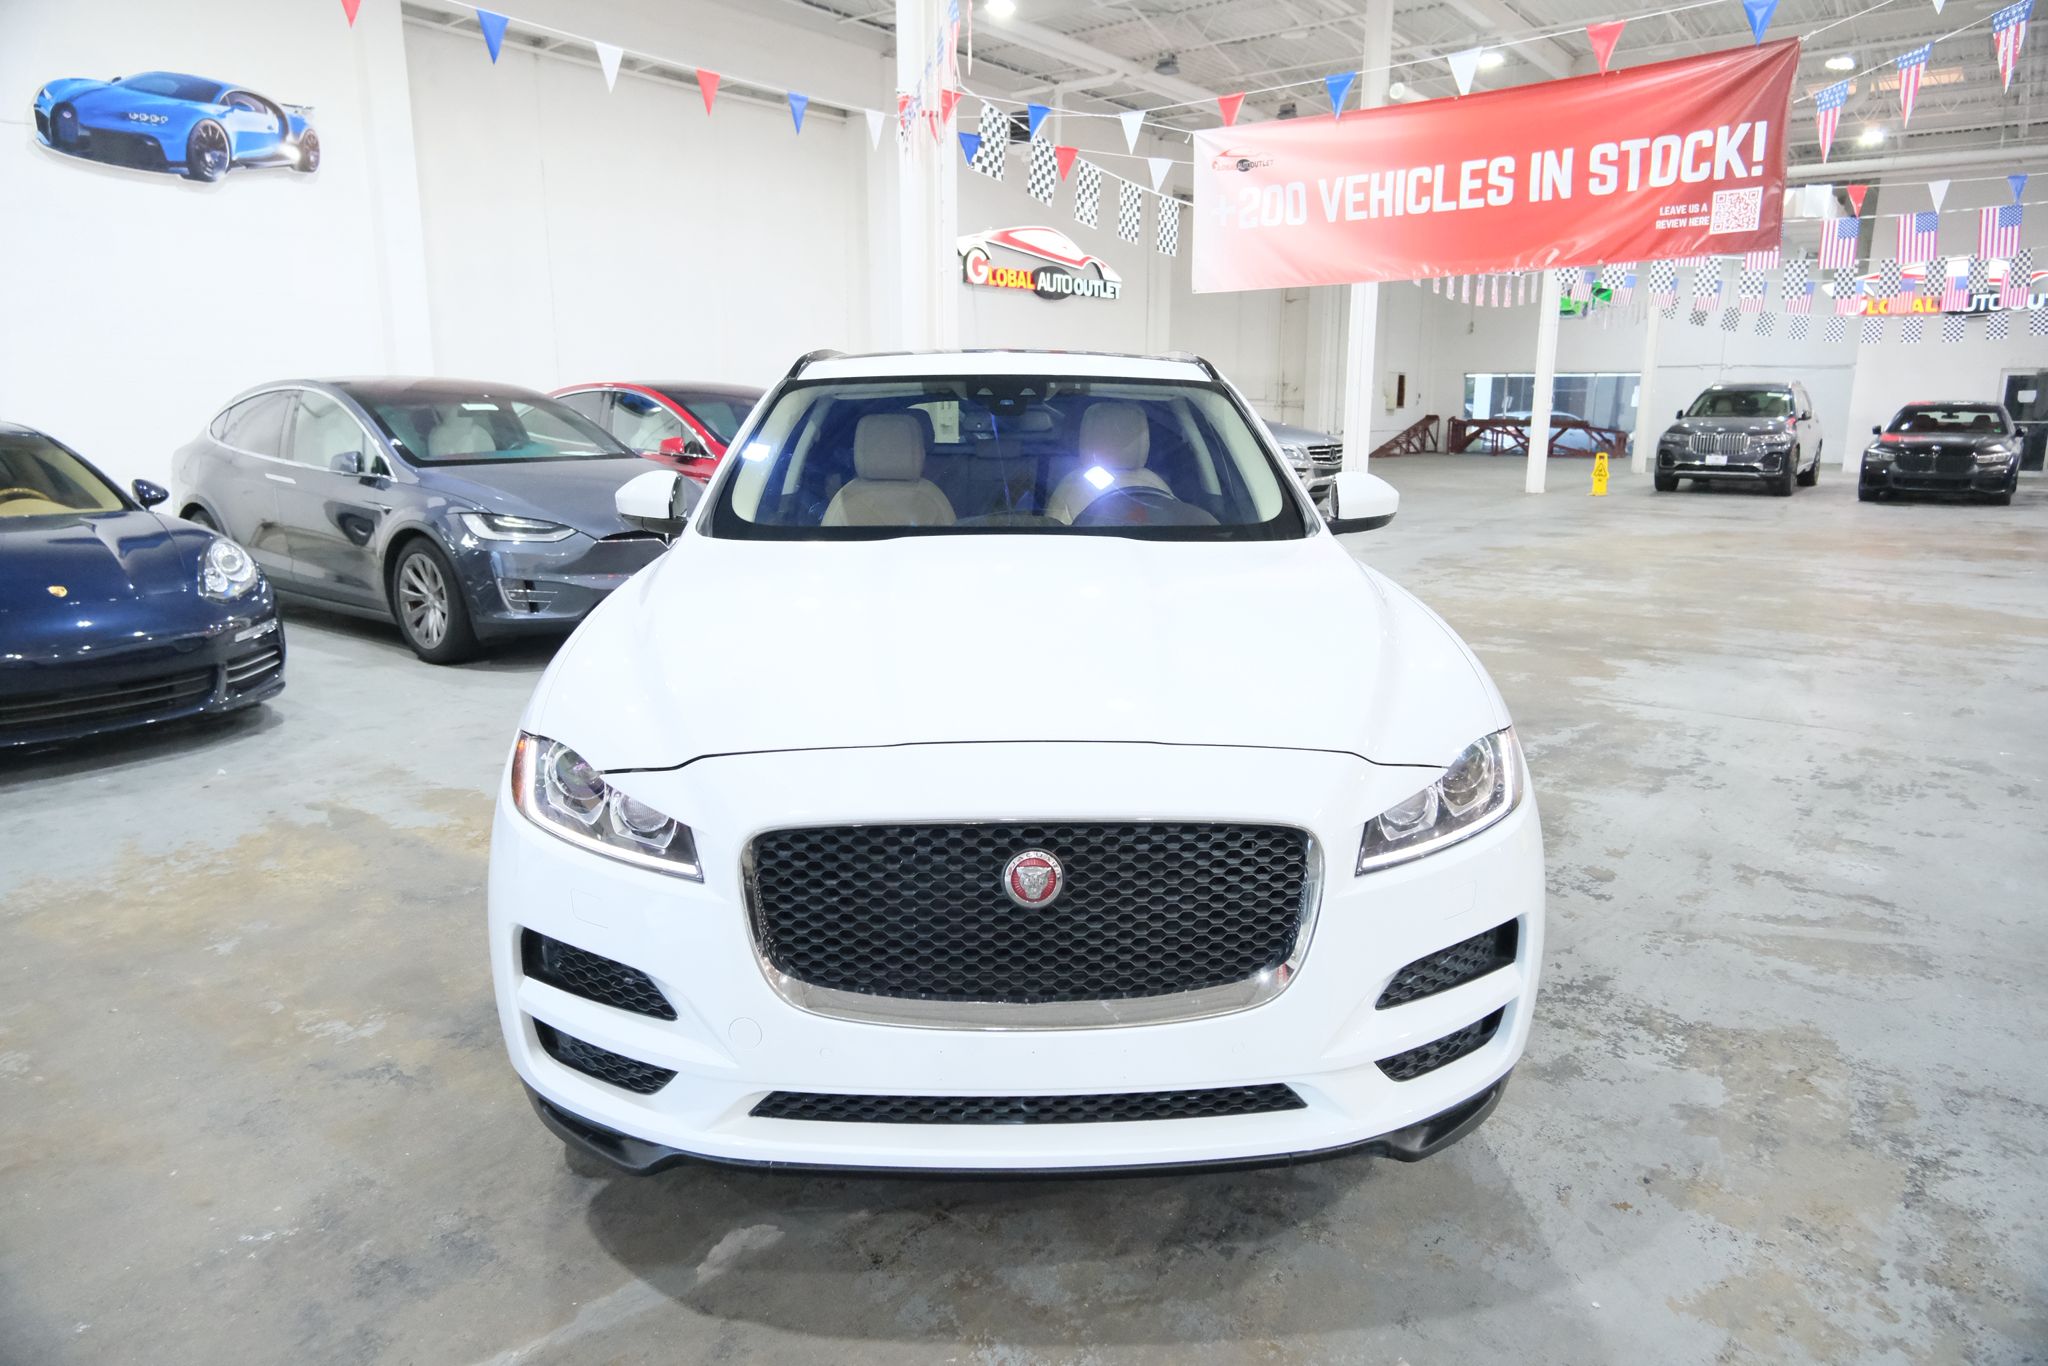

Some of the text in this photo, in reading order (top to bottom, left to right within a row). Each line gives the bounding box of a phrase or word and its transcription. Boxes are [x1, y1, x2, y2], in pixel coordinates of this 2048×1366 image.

[1209, 120, 1767, 229] +200 VEHICLES IN STOCK!
[1655, 215, 1710, 230] REVIEW HERE
[1659, 203, 1708, 216] LEAVE US A
[966, 248, 1122, 300] GLOBAL AUTO OUTLET
